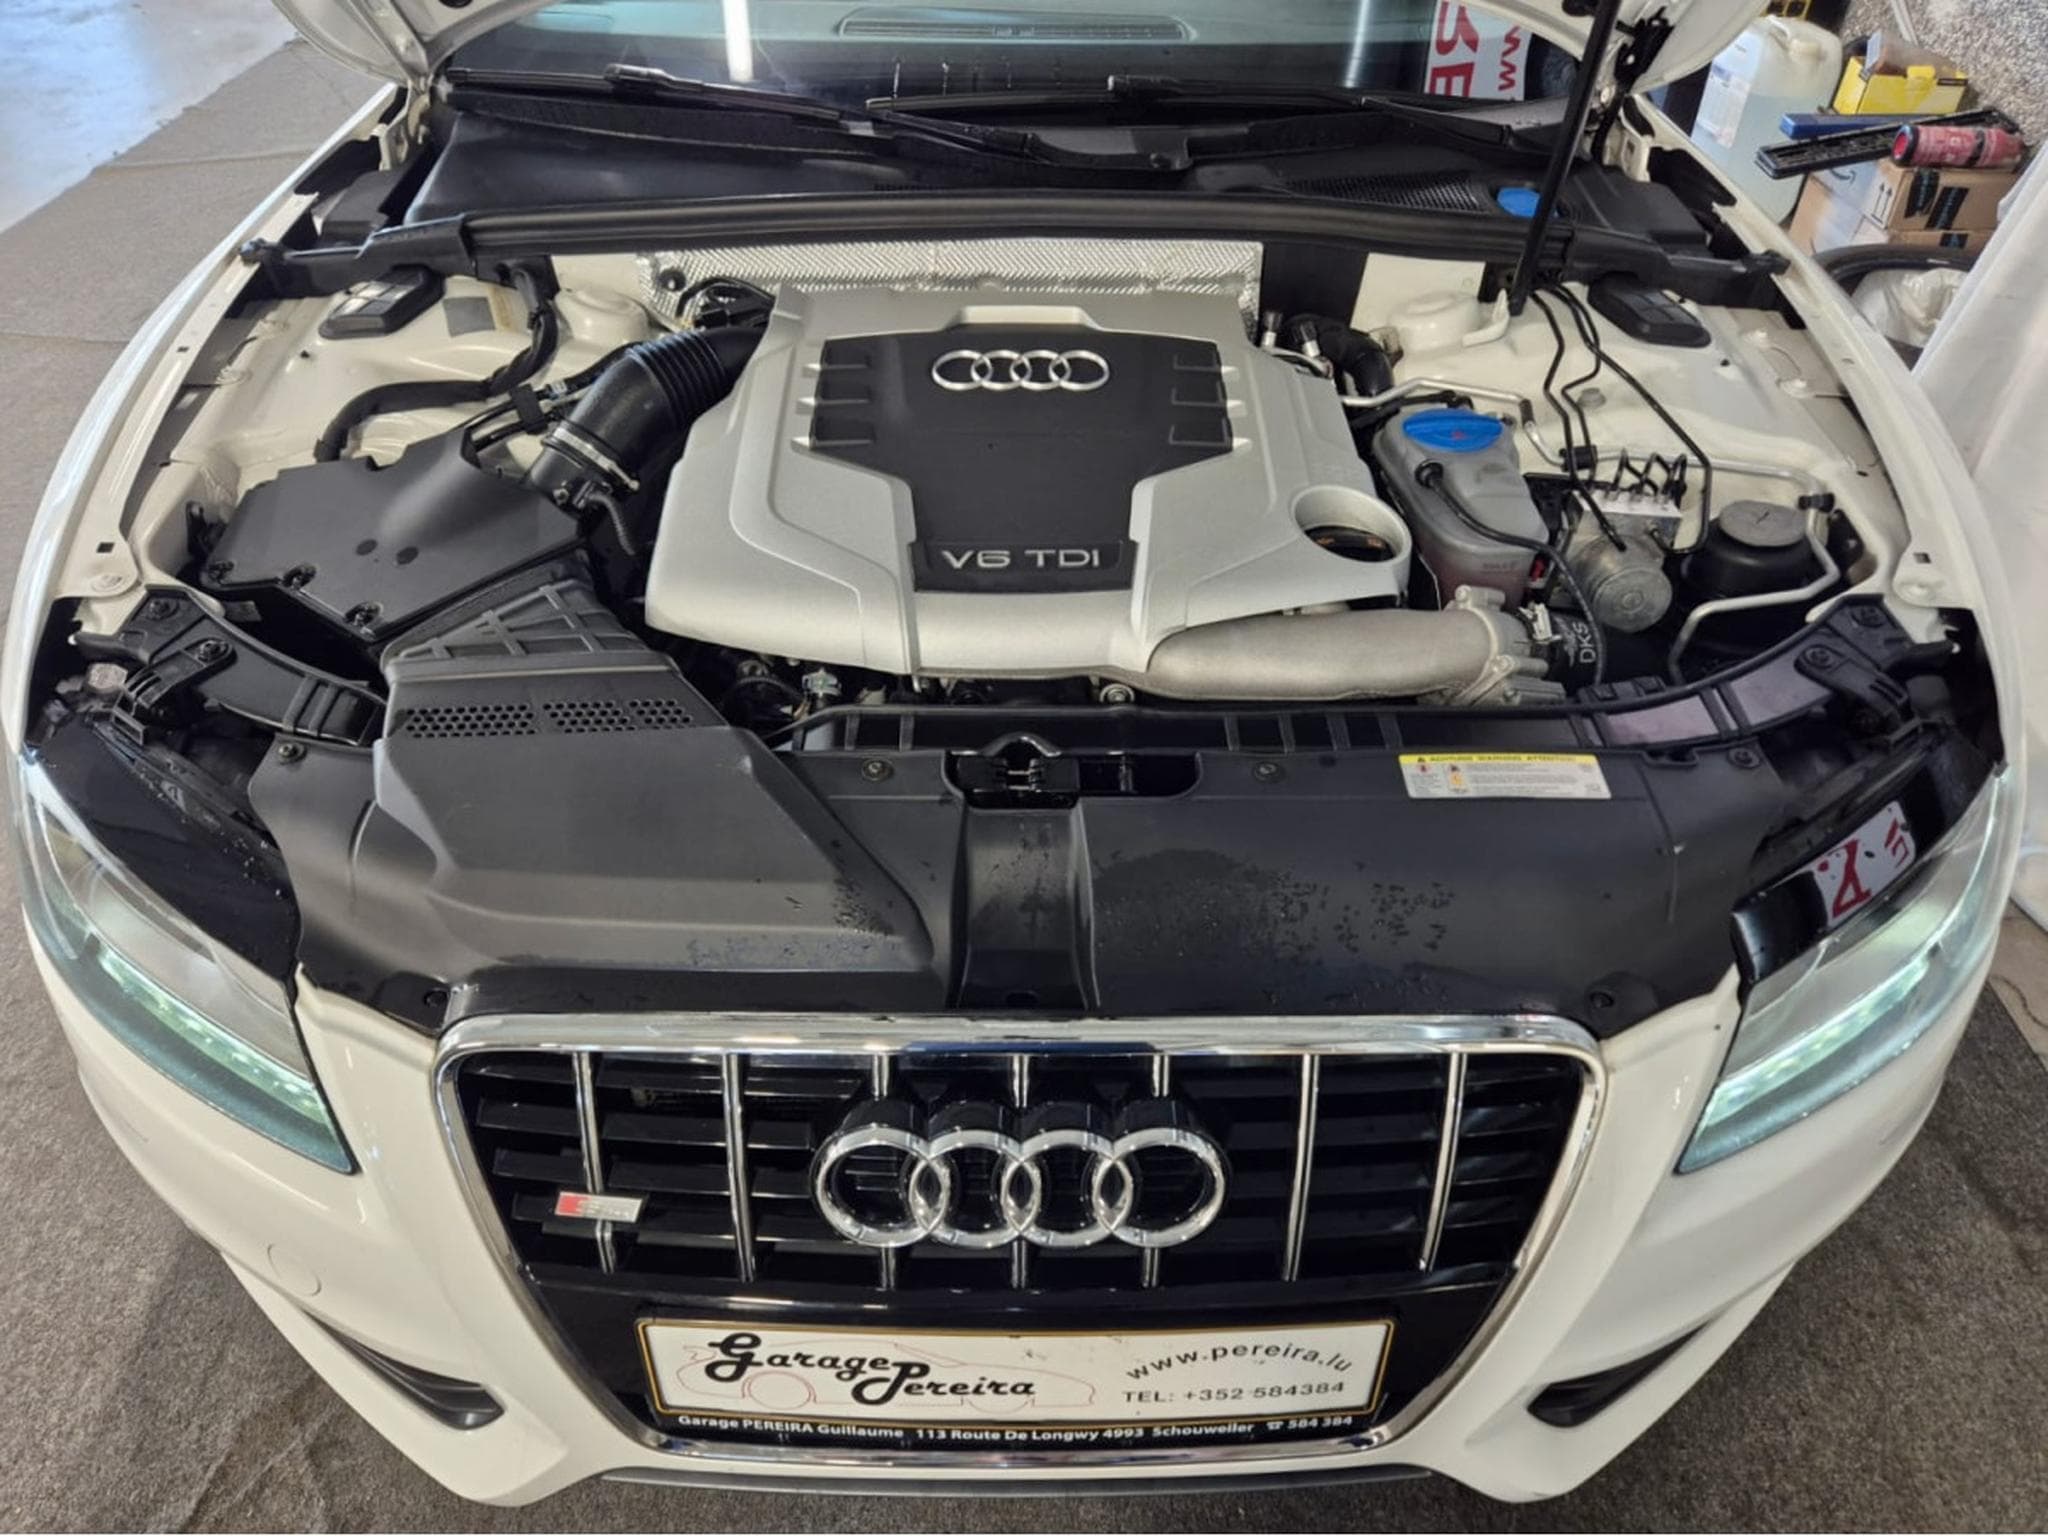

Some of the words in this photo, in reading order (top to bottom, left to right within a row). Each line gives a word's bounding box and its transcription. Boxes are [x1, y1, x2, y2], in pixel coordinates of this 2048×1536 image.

[941, 549, 1011, 569] V6
[1024, 549, 1100, 568] TDI
[1572, 622, 1596, 663] DKS
[704, 1332, 889, 1383] Garage
[1126, 1342, 1353, 1380] www.pereira.lu
[851, 1361, 1036, 1405] Pereira
[1123, 1390, 1174, 1403] TEL:
[1185, 1387, 1243, 1401] +352
[1253, 1381, 1345, 1399] 584384
[678, 1415, 739, 1430] Garage
[742, 1419, 814, 1433] PEREIRA
[817, 1424, 904, 1439] Guillaume
[916, 1429, 946, 1440] 113
[951, 1429, 999, 1440] Route
[1005, 1429, 1028, 1441] De
[1032, 1430, 1099, 1442] Longwy
[1102, 1427, 1144, 1439] 4993
[1152, 1421, 1255, 1438] Schouweiler
[1287, 1418, 1321, 1430] 584
[1322, 1416, 1353, 1427] 384
